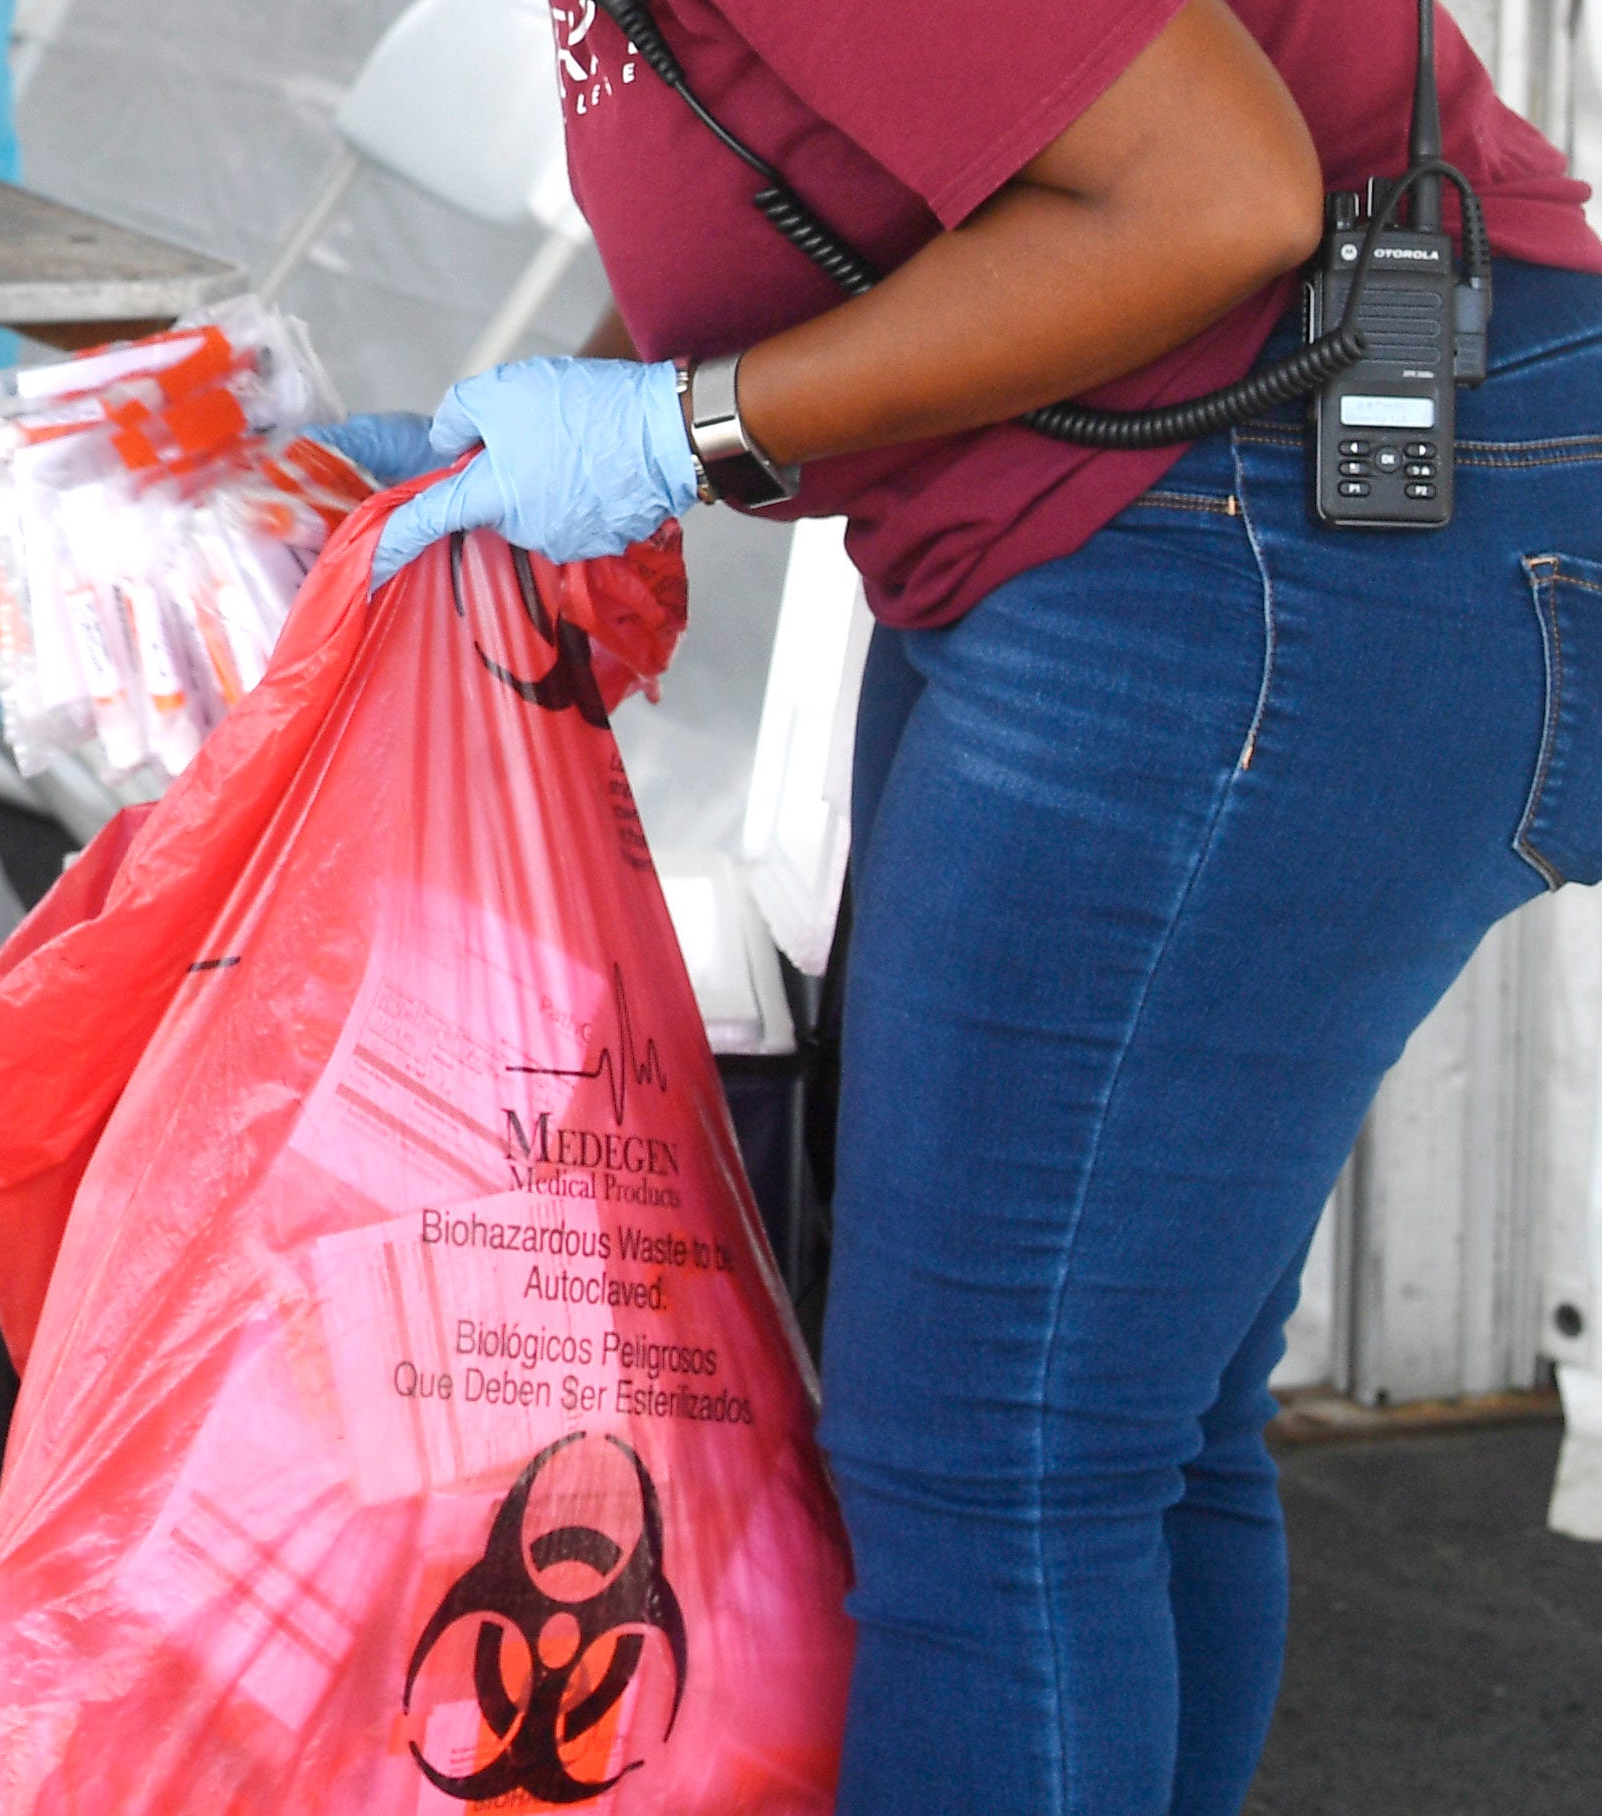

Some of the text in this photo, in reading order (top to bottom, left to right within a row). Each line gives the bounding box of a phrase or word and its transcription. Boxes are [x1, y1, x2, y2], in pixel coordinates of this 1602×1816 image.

[1374, 248, 1439, 261] OTOROLA
[509, 1165, 682, 1209] Medical Products
[421, 1209, 611, 1261] Biohazardous
[618, 1225, 687, 1267] Waste
[693, 1239, 711, 1271] to
[524, 1265, 668, 1311] Autoclaved.
[456, 1319, 717, 1379] Biológicos Peligrosos
[394, 1360, 453, 1401] Que
[464, 1367, 551, 1408] Deben
[560, 1375, 607, 1412] Ser
